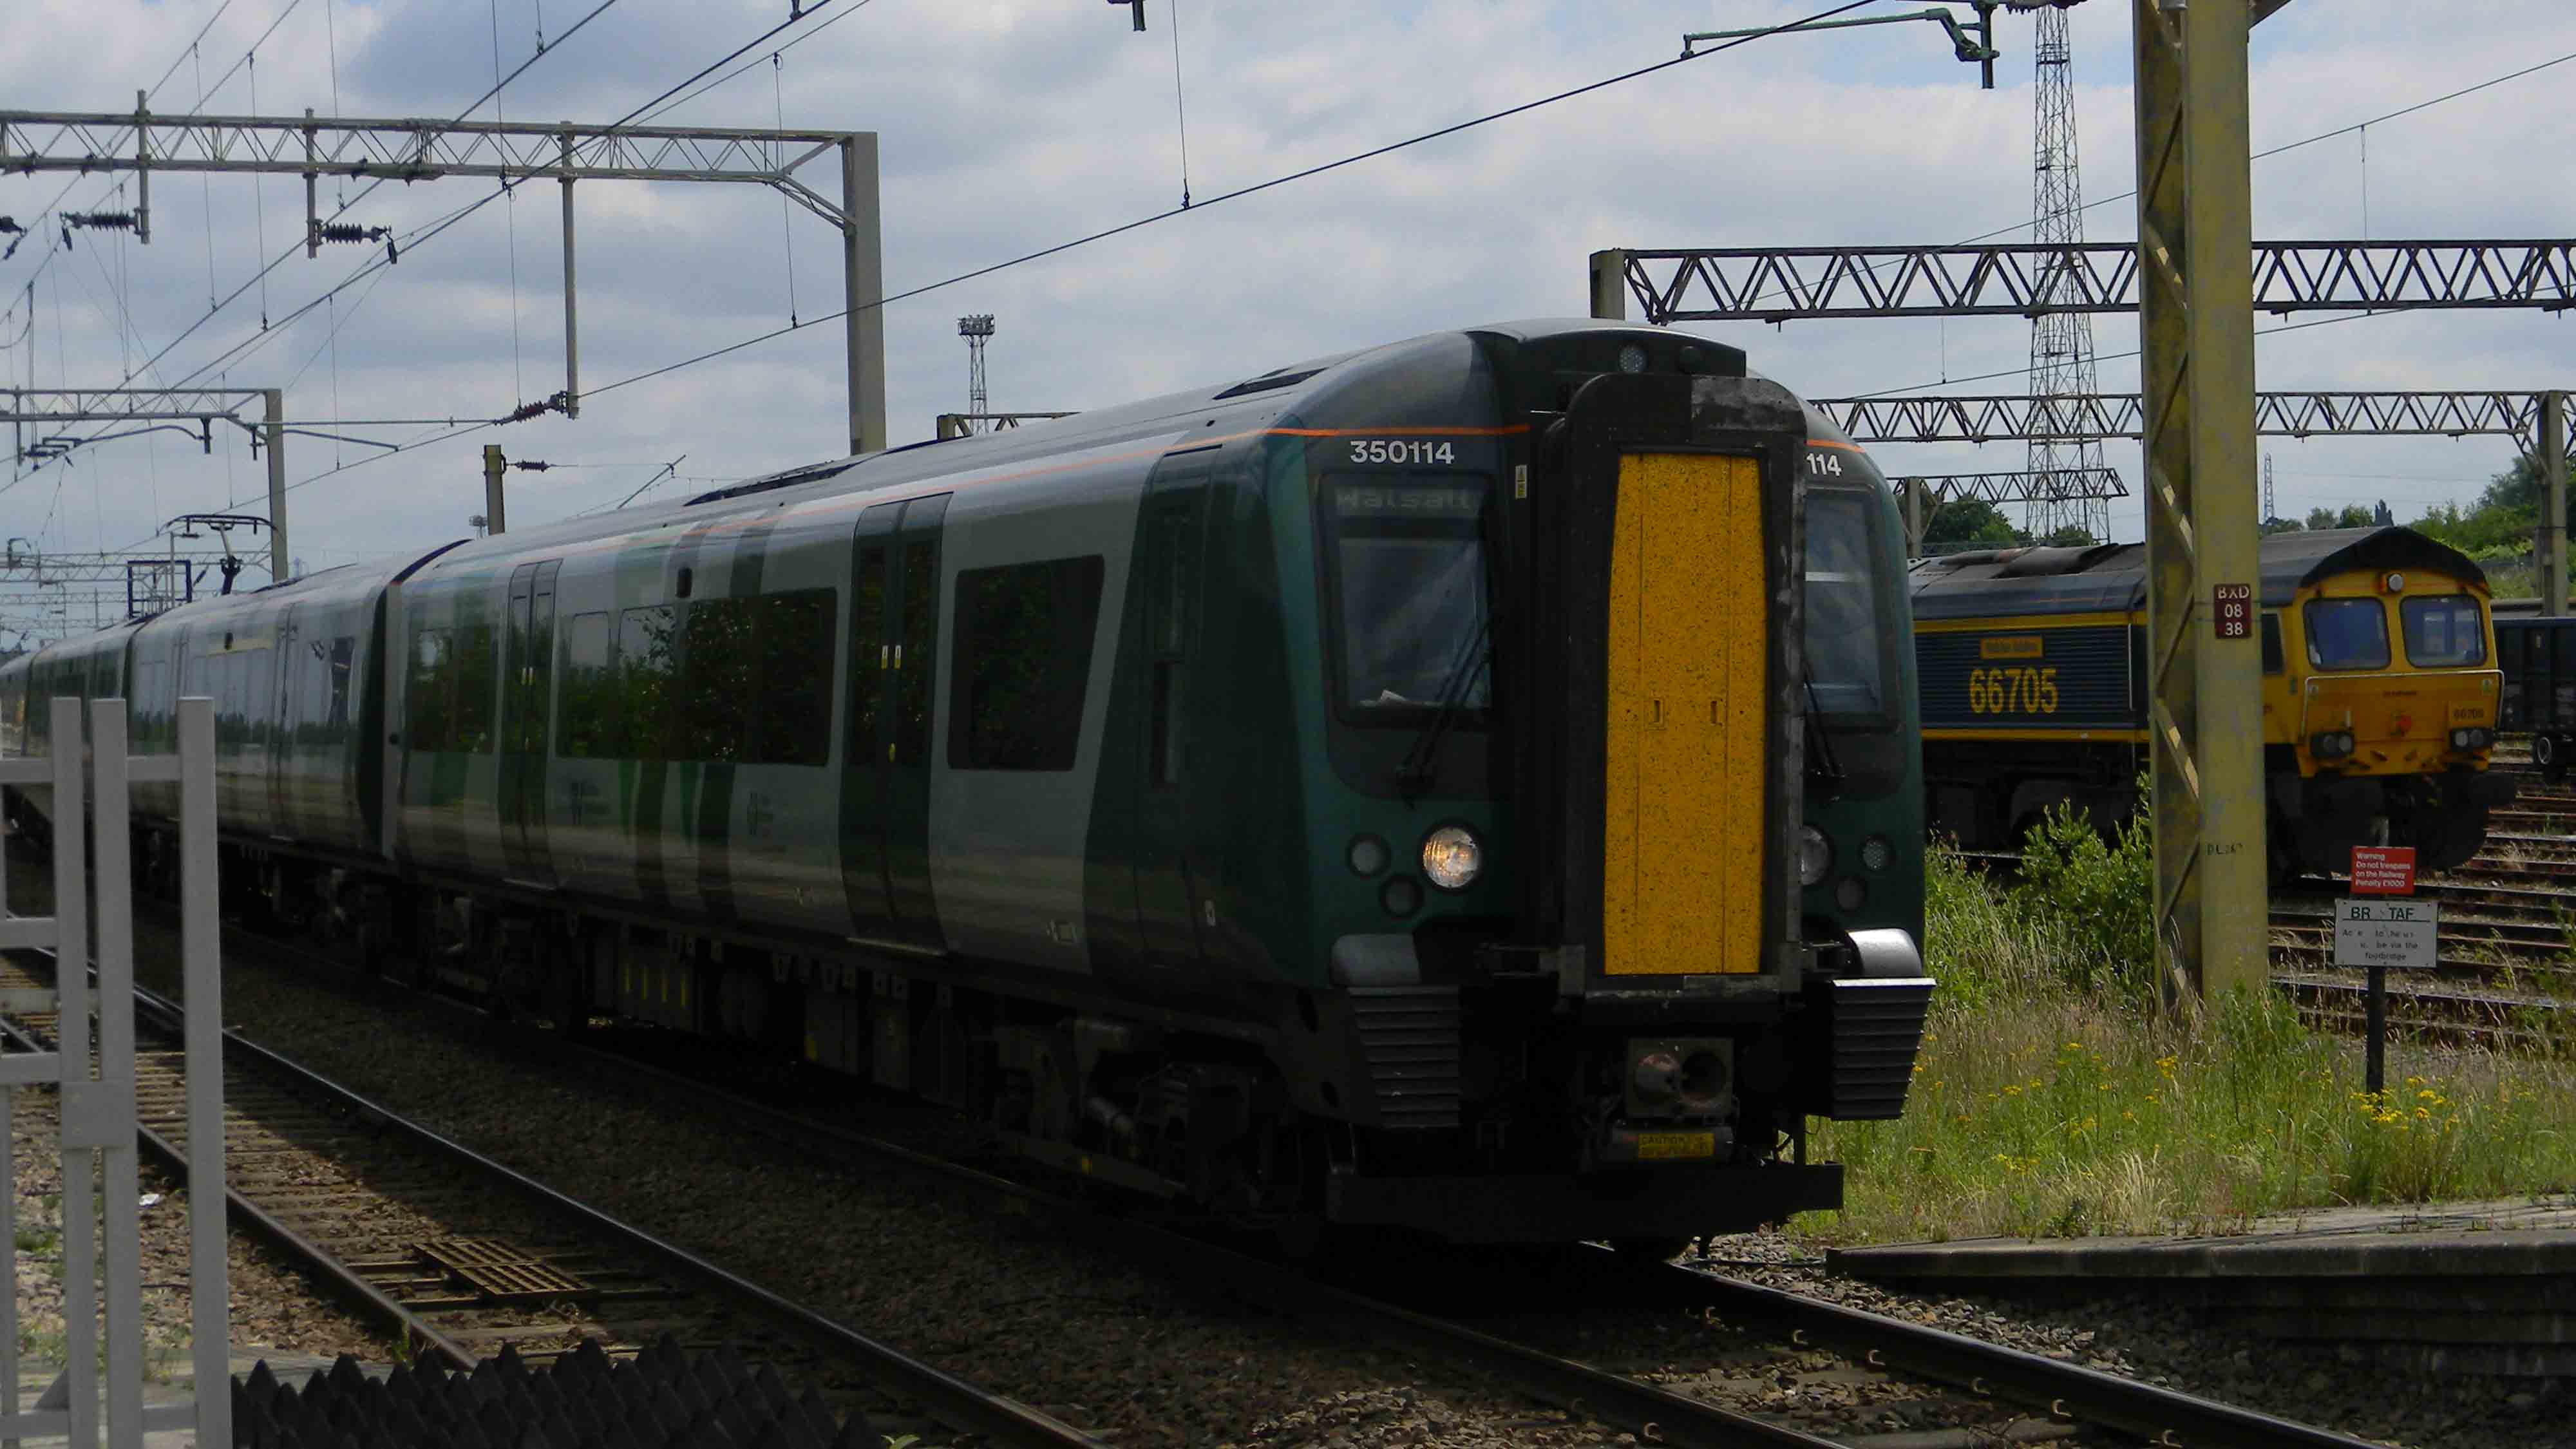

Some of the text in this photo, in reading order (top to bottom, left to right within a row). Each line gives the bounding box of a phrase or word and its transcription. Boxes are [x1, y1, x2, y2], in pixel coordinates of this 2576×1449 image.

[1350, 440, 1455, 464] 350114
[2225, 603, 2243, 618] 08
[2225, 621, 2243, 636] 38
[1969, 667, 2058, 713] 66705
[2351, 907, 2371, 919] BR
